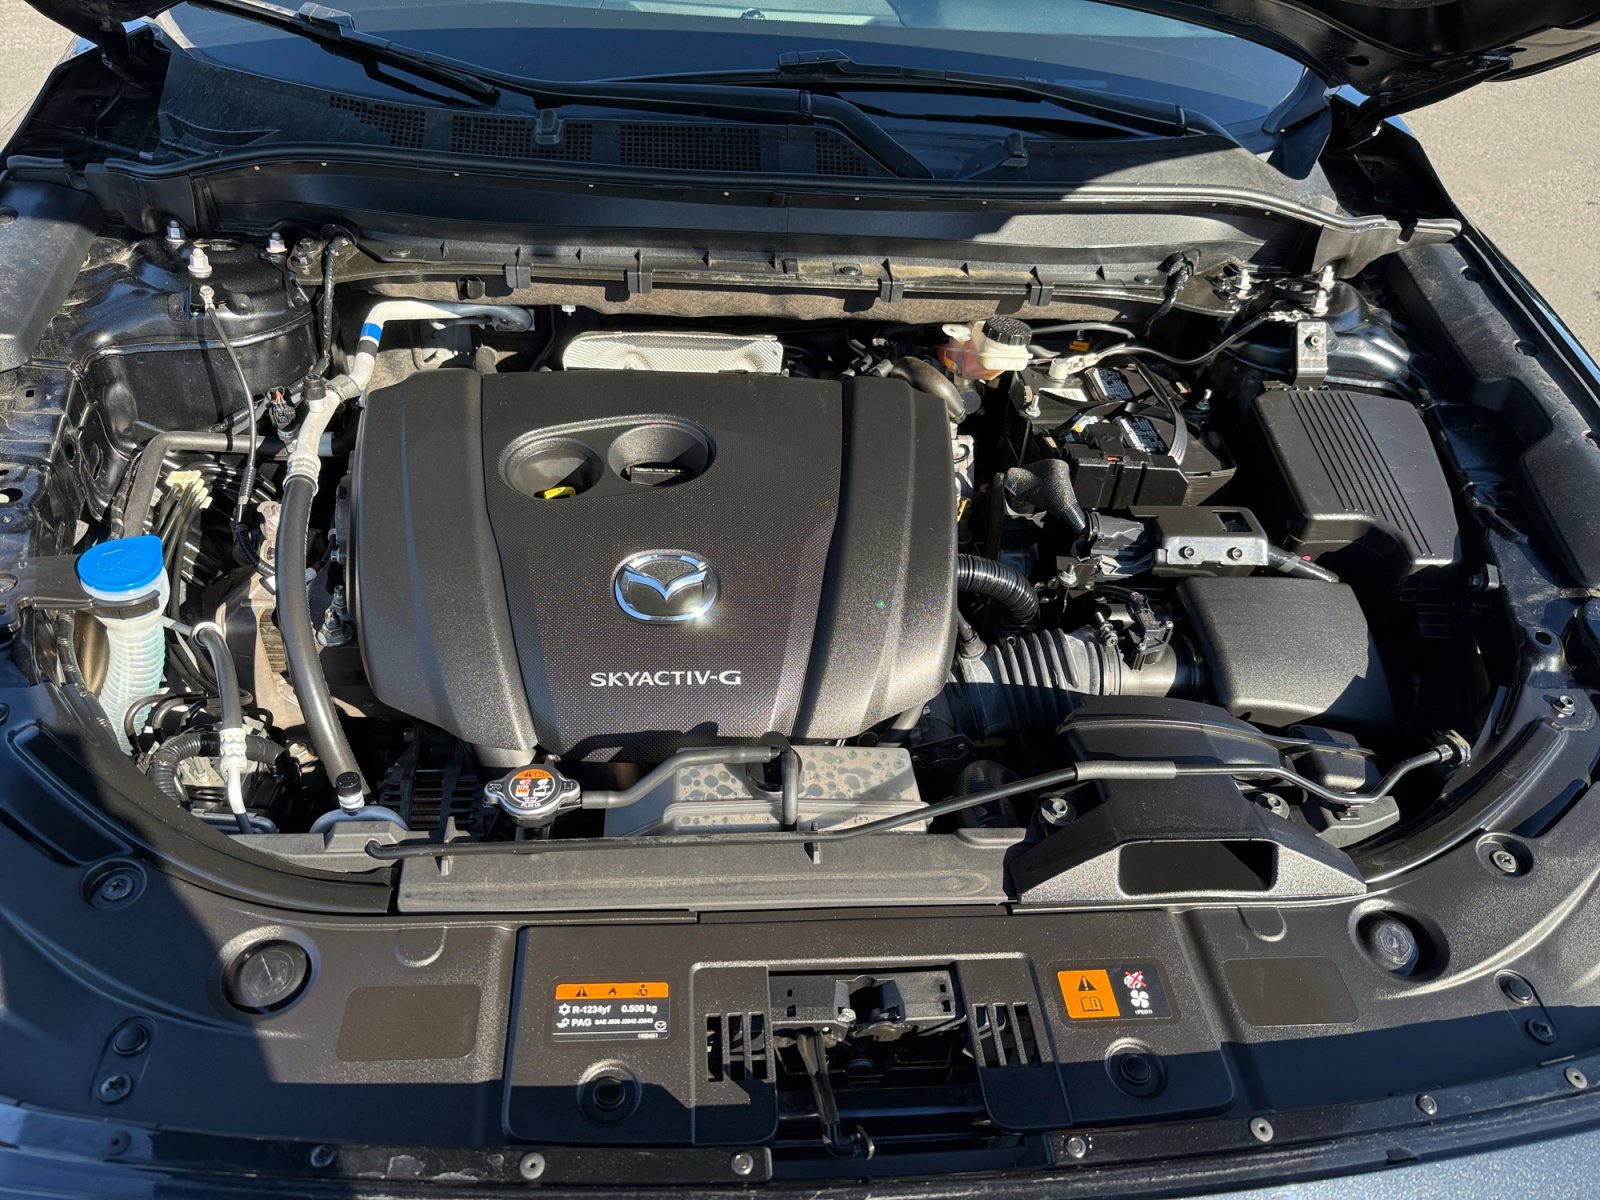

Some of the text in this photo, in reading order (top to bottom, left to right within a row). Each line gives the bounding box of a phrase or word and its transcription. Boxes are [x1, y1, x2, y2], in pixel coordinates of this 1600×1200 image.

[590, 670, 741, 687] SKYACTIV-G
[571, 1004, 658, 1015] R-1234yf 0.500 kg
[571, 1018, 592, 1027] PAG
